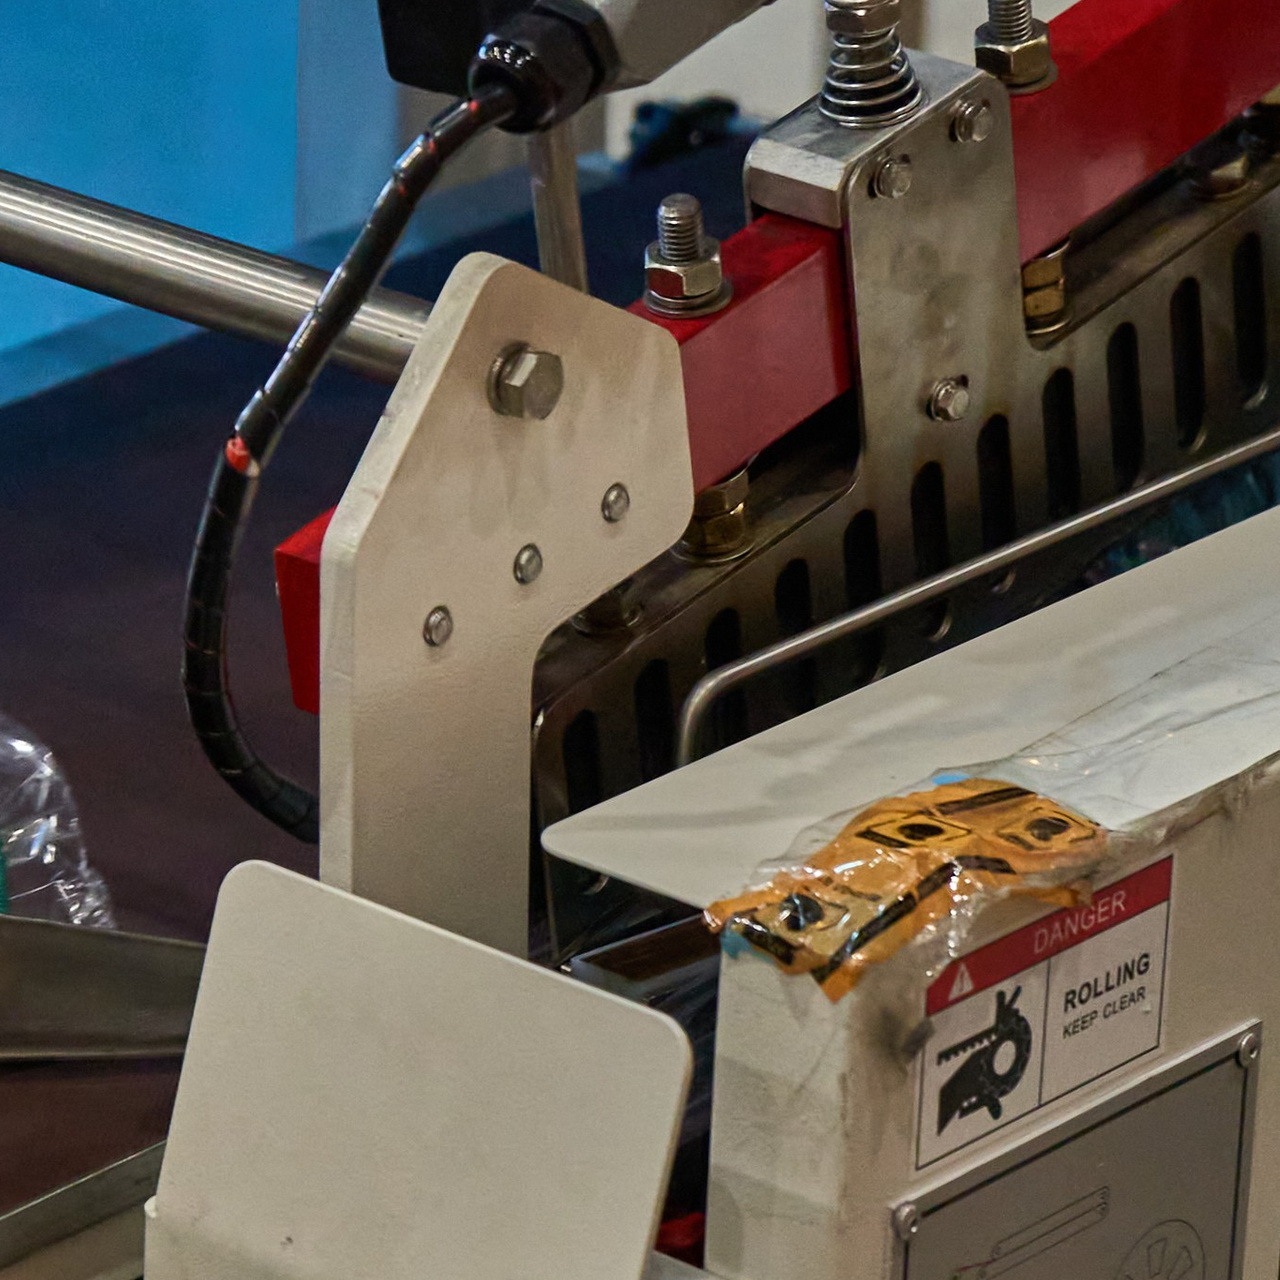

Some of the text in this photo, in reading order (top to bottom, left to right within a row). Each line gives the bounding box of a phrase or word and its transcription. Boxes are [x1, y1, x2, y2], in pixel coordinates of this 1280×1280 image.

[1033, 889, 1127, 955] DANGER
[1062, 986, 1146, 1040] KEEP CLEAR
[1064, 952, 1151, 1014] ROLLING
